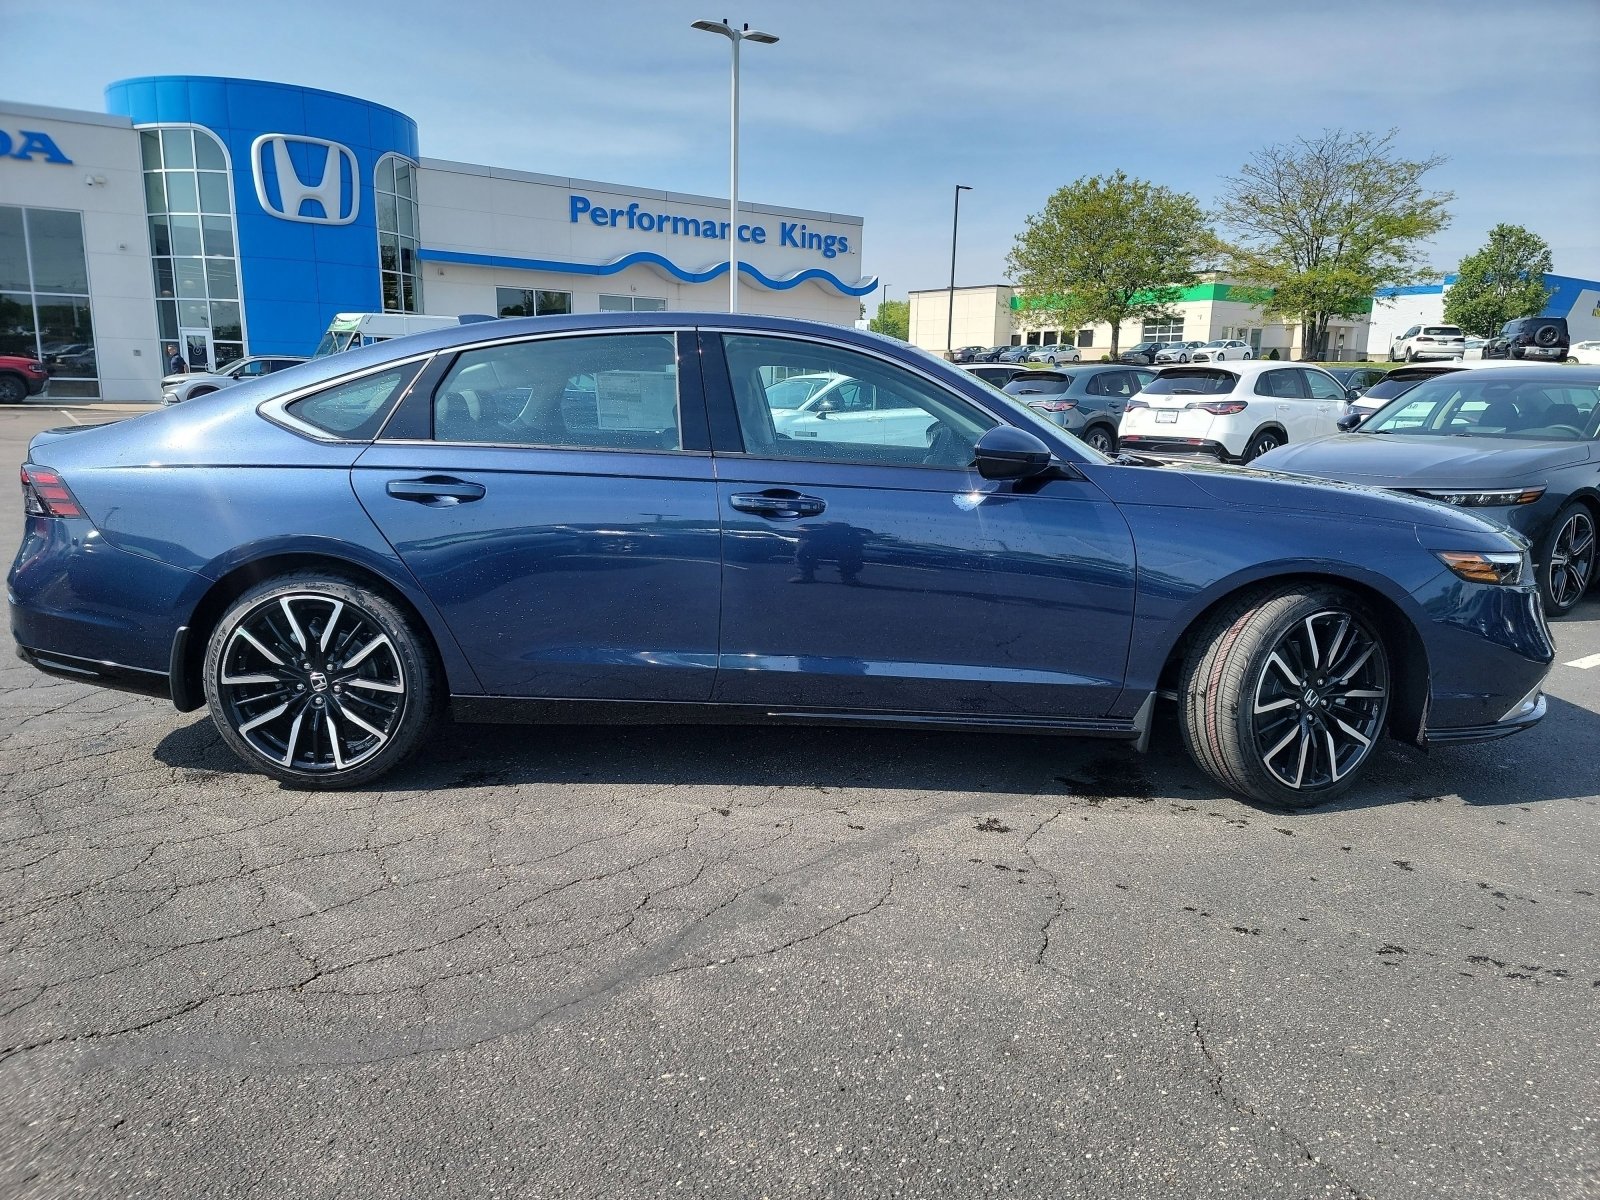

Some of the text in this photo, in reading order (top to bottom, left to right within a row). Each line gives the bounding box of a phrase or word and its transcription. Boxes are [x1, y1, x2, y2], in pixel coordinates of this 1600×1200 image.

[0, 129, 73, 165] A
[569, 194, 849, 259] Performance Kings
